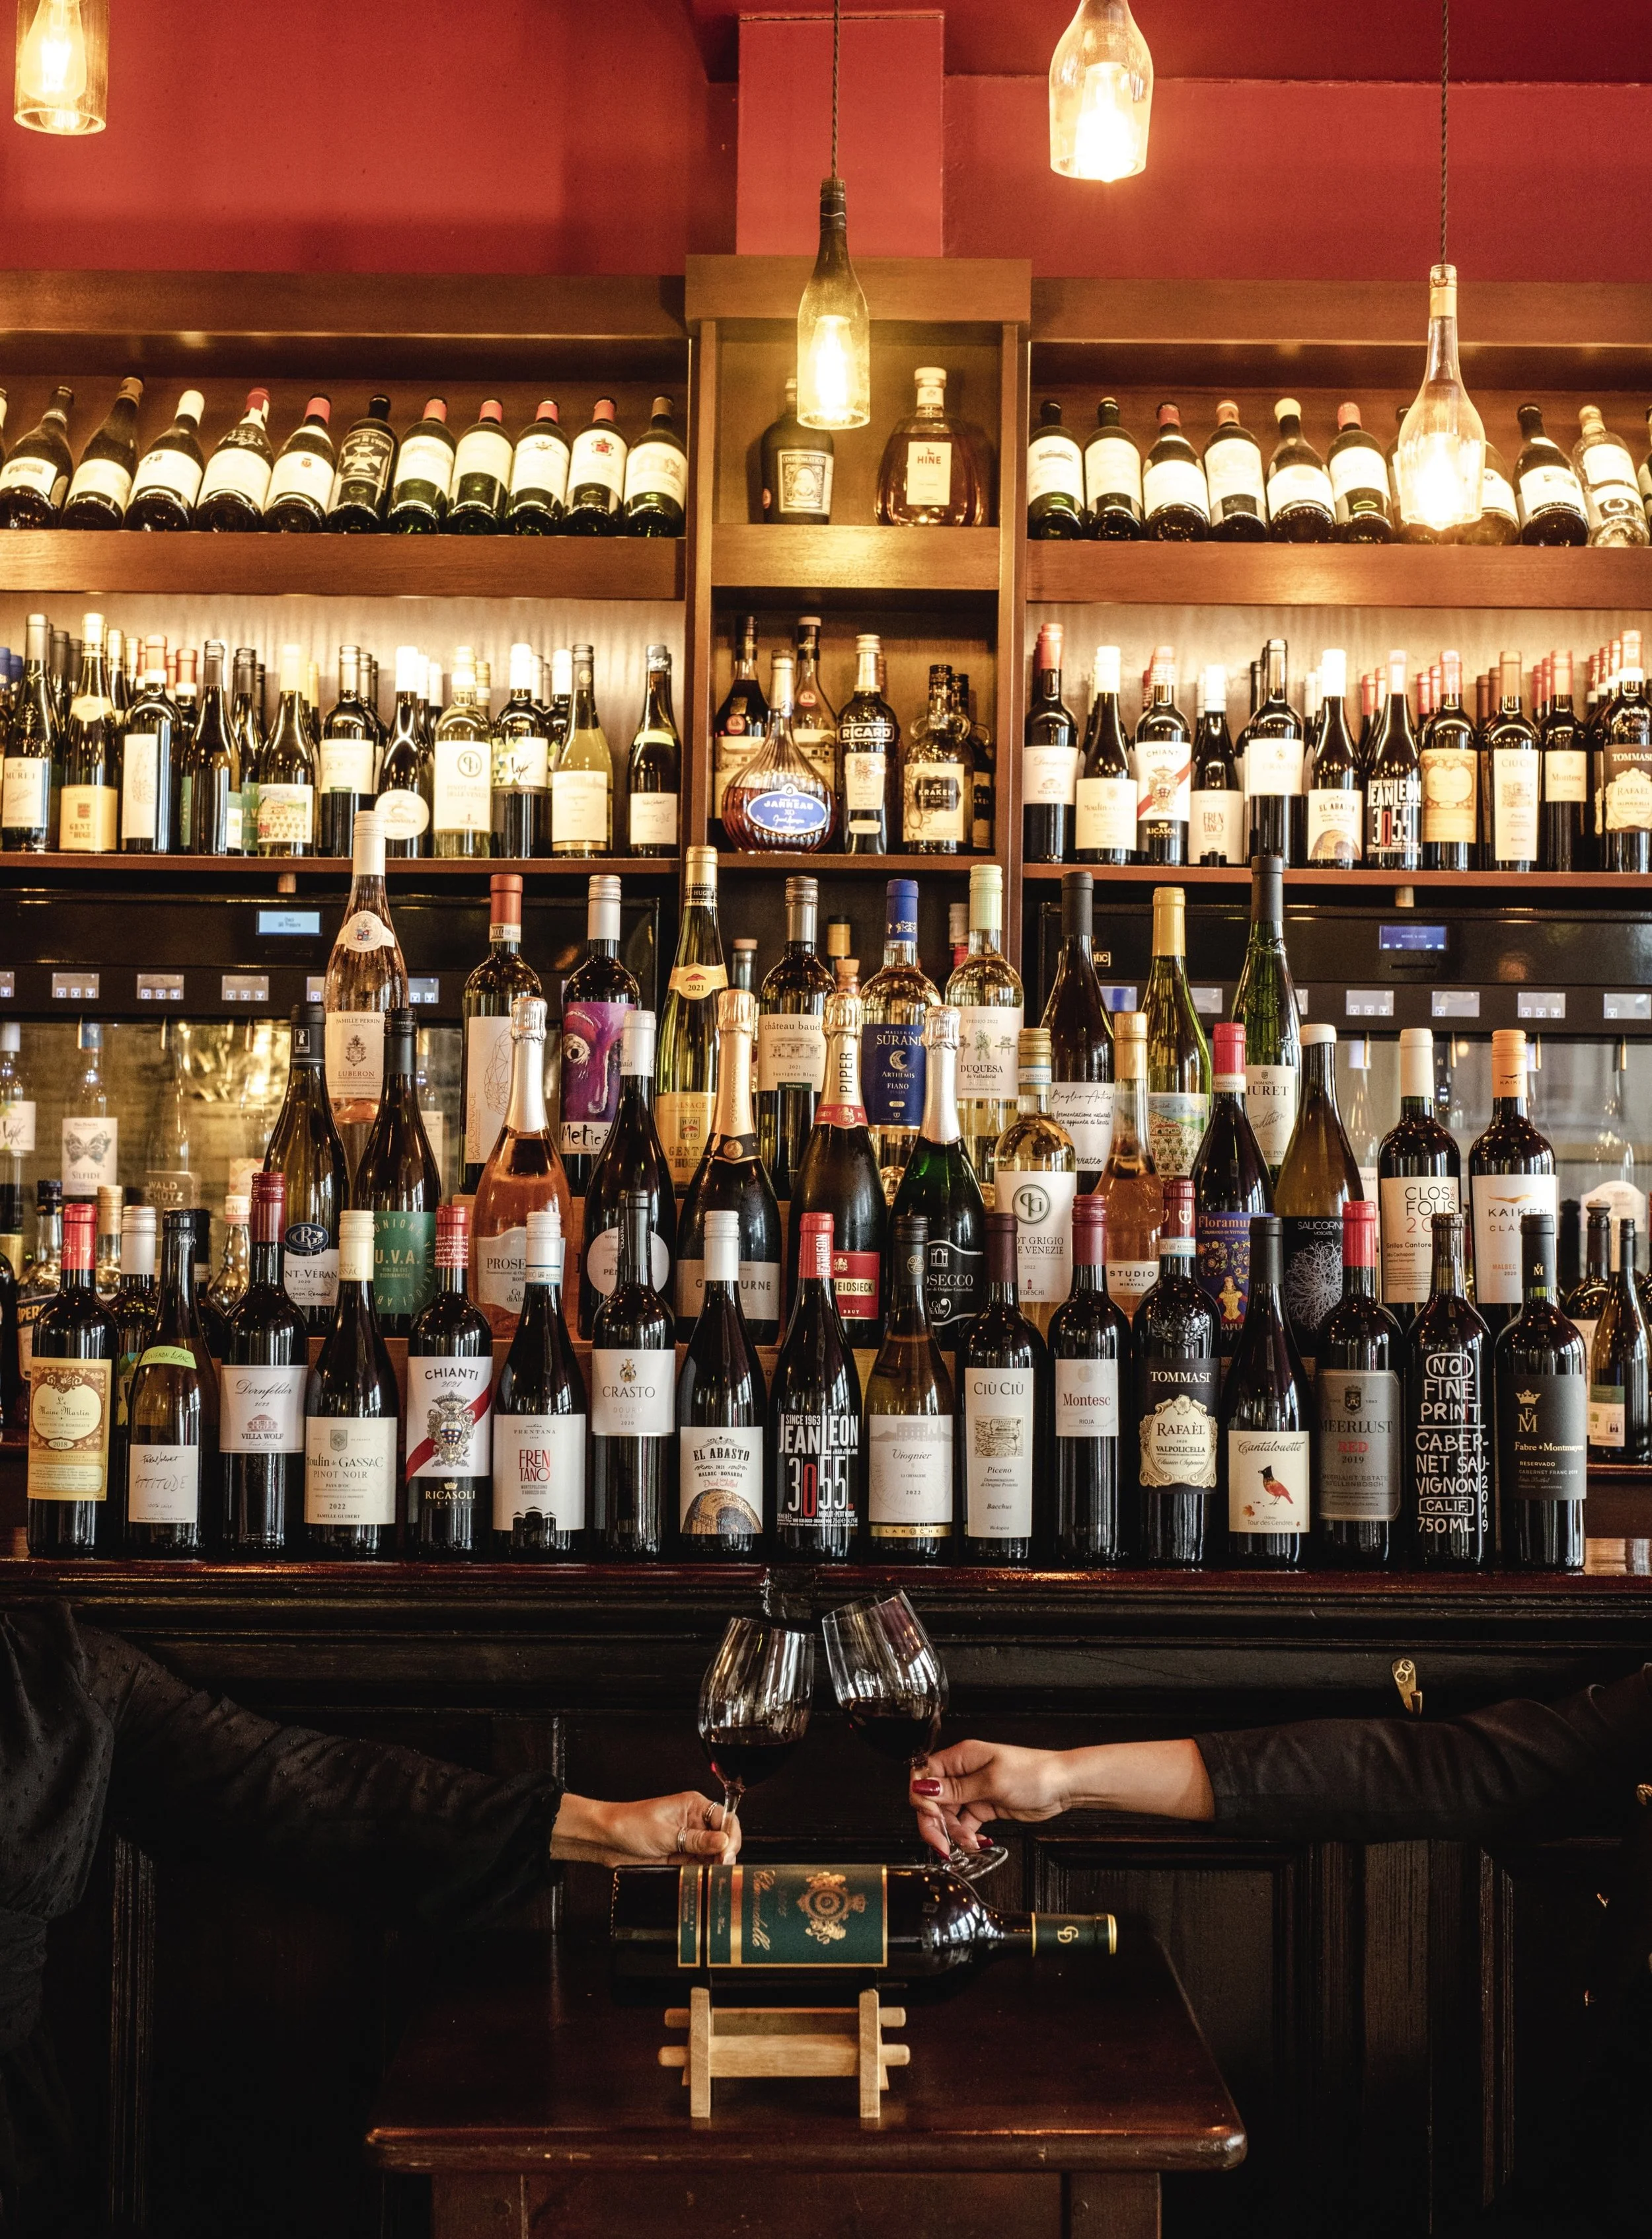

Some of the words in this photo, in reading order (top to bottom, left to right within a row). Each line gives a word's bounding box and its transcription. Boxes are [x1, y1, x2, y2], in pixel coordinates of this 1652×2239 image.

[917, 456, 941, 465] HINE
[843, 727, 891, 738] RICARD
[764, 800, 814, 810] JANNEAU
[765, 1021, 795, 1031] château
[839, 1052, 853, 1093] PIPER
[961, 1065, 1003, 1073] DUQUESA
[71, 1171, 100, 1180] SILFIDE
[1406, 1187, 1449, 1200] CLOS
[1406, 1201, 1455, 1215] FOUS
[1488, 1207, 1546, 1217] KAIKEN
[1298, 1221, 1343, 1230] SALICORNI
[375, 1250, 420, 1264] U.V.A.
[1433, 1358, 1462, 1375] NO
[425, 1367, 478, 1381] CHIANTI
[1150, 1371, 1211, 1383] TOMMASI
[235, 1379, 292, 1398] Dornfelder
[603, 1386, 656, 1398] CRASTO
[974, 1381, 996, 1395] CIÙ
[1000, 1381, 1024, 1394] CIÙ
[1425, 1379, 1476, 1400] FINE
[56, 1396, 66, 1405] Le
[1063, 1393, 1111, 1406] Montesc
[38, 1406, 58, 1416] Maine
[61, 1406, 89, 1416] Martin
[1421, 1404, 1481, 1422] PRINT
[786, 1416, 804, 1425] SINCE
[805, 1416, 821, 1425] 1963
[779, 1414, 821, 1455] JEAN
[822, 1409, 858, 1454] LEON
[1157, 1422, 1205, 1436] RAFAÈL
[1320, 1422, 1393, 1433] MEERLUST
[1238, 1440, 1305, 1454] Cantalouette
[1338, 1441, 1368, 1453] RED
[1416, 1433, 1489, 1452] CABER-
[1515, 1442, 1537, 1451] Fabre
[519, 1449, 550, 1468] FREN
[693, 1451, 706, 1461] EL
[710, 1448, 750, 1461] ABASTO
[892, 1449, 932, 1462] Viognier
[338, 1457, 383, 1468] GASSAC
[1417, 1456, 1449, 1474] NET
[1458, 1455, 1490, 1474] SAU-
[519, 1467, 550, 1482] TANO
[135, 1475, 188, 1491] ATTITUDE
[1416, 1478, 1478, 1496] VIGNON
[426, 1490, 476, 1499] RICASOLI
[1426, 1499, 1467, 1511] CALIF.
